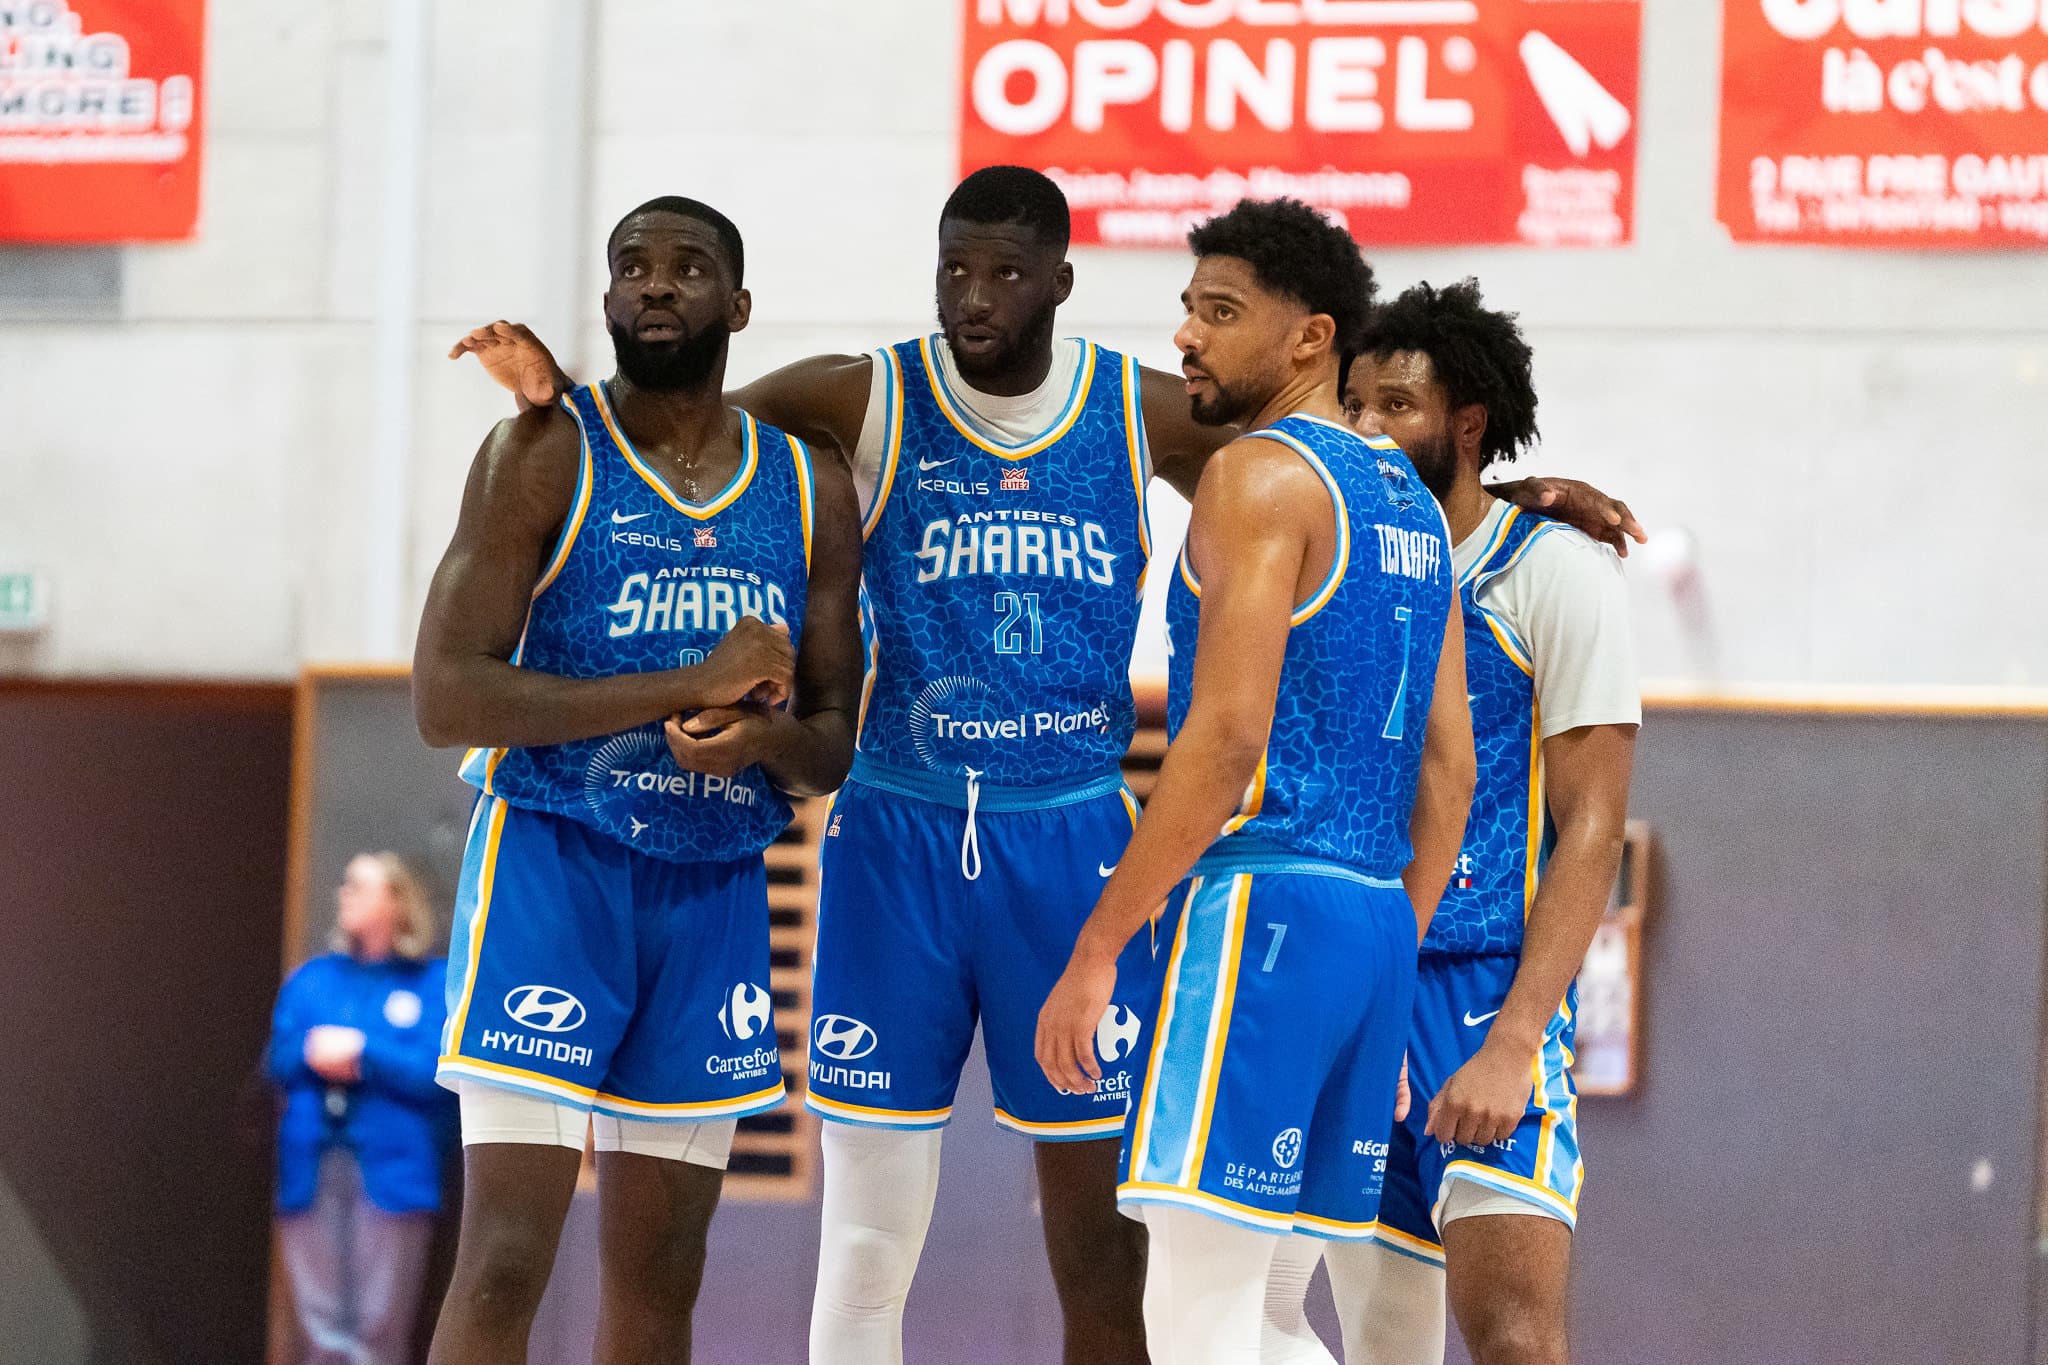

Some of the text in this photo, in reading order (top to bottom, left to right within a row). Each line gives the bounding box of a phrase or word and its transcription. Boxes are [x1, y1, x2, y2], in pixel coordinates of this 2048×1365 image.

[972, 37, 1474, 136] OPINEL
[957, 510, 1077, 527] ANTIBES
[914, 519, 1118, 586] SHARKS
[655, 567, 761, 585] ANTIBES
[607, 572, 787, 638] SHARKS
[994, 591, 1043, 655] 21
[930, 701, 1111, 740] Travel Planet
[610, 769, 756, 808] Travel Plan
[481, 1029, 593, 1068] HYUNDAI
[706, 1047, 778, 1075] Carrefou
[732, 1067, 768, 1081] ANTIBES
[1352, 1139, 1390, 1157] RÉGIO
[1223, 1176, 1244, 1190] DES
